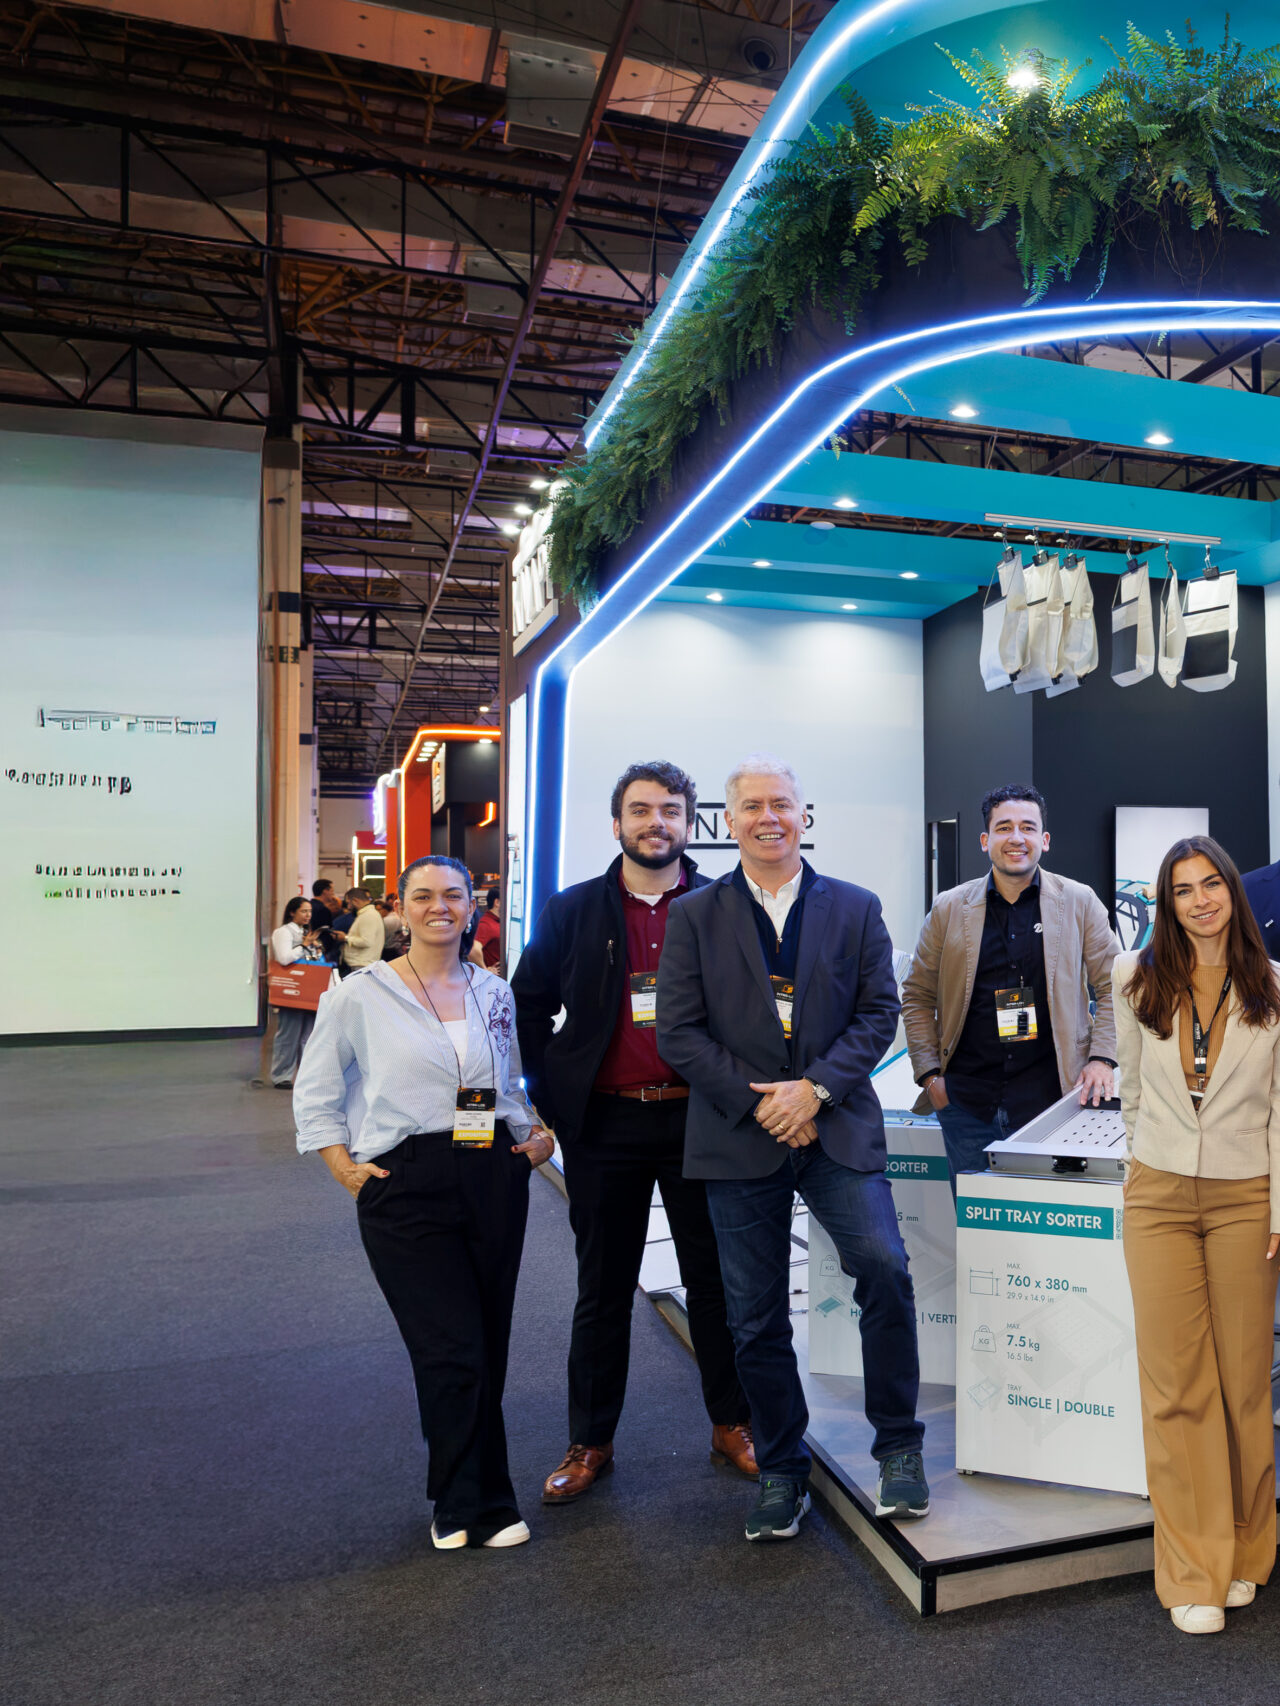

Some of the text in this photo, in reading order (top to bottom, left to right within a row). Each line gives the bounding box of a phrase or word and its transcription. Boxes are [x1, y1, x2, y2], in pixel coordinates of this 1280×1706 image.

[886, 1161, 929, 1174] SORTER
[965, 1206, 1002, 1222] SPLIT
[1005, 1209, 1042, 1225] TRAY
[1046, 1212, 1102, 1230] SORTER
[1007, 1274, 1087, 1293] 760 x 380 mm
[1007, 1291, 1022, 1300] 29.9
[1031, 1293, 1045, 1302] 14.9
[1006, 1334, 1040, 1351] 7.5 kg
[1007, 1352, 1033, 1362] 16.5 lbs
[1007, 1394, 1052, 1410] SINGLE
[1064, 1401, 1115, 1417] DOUBLE
